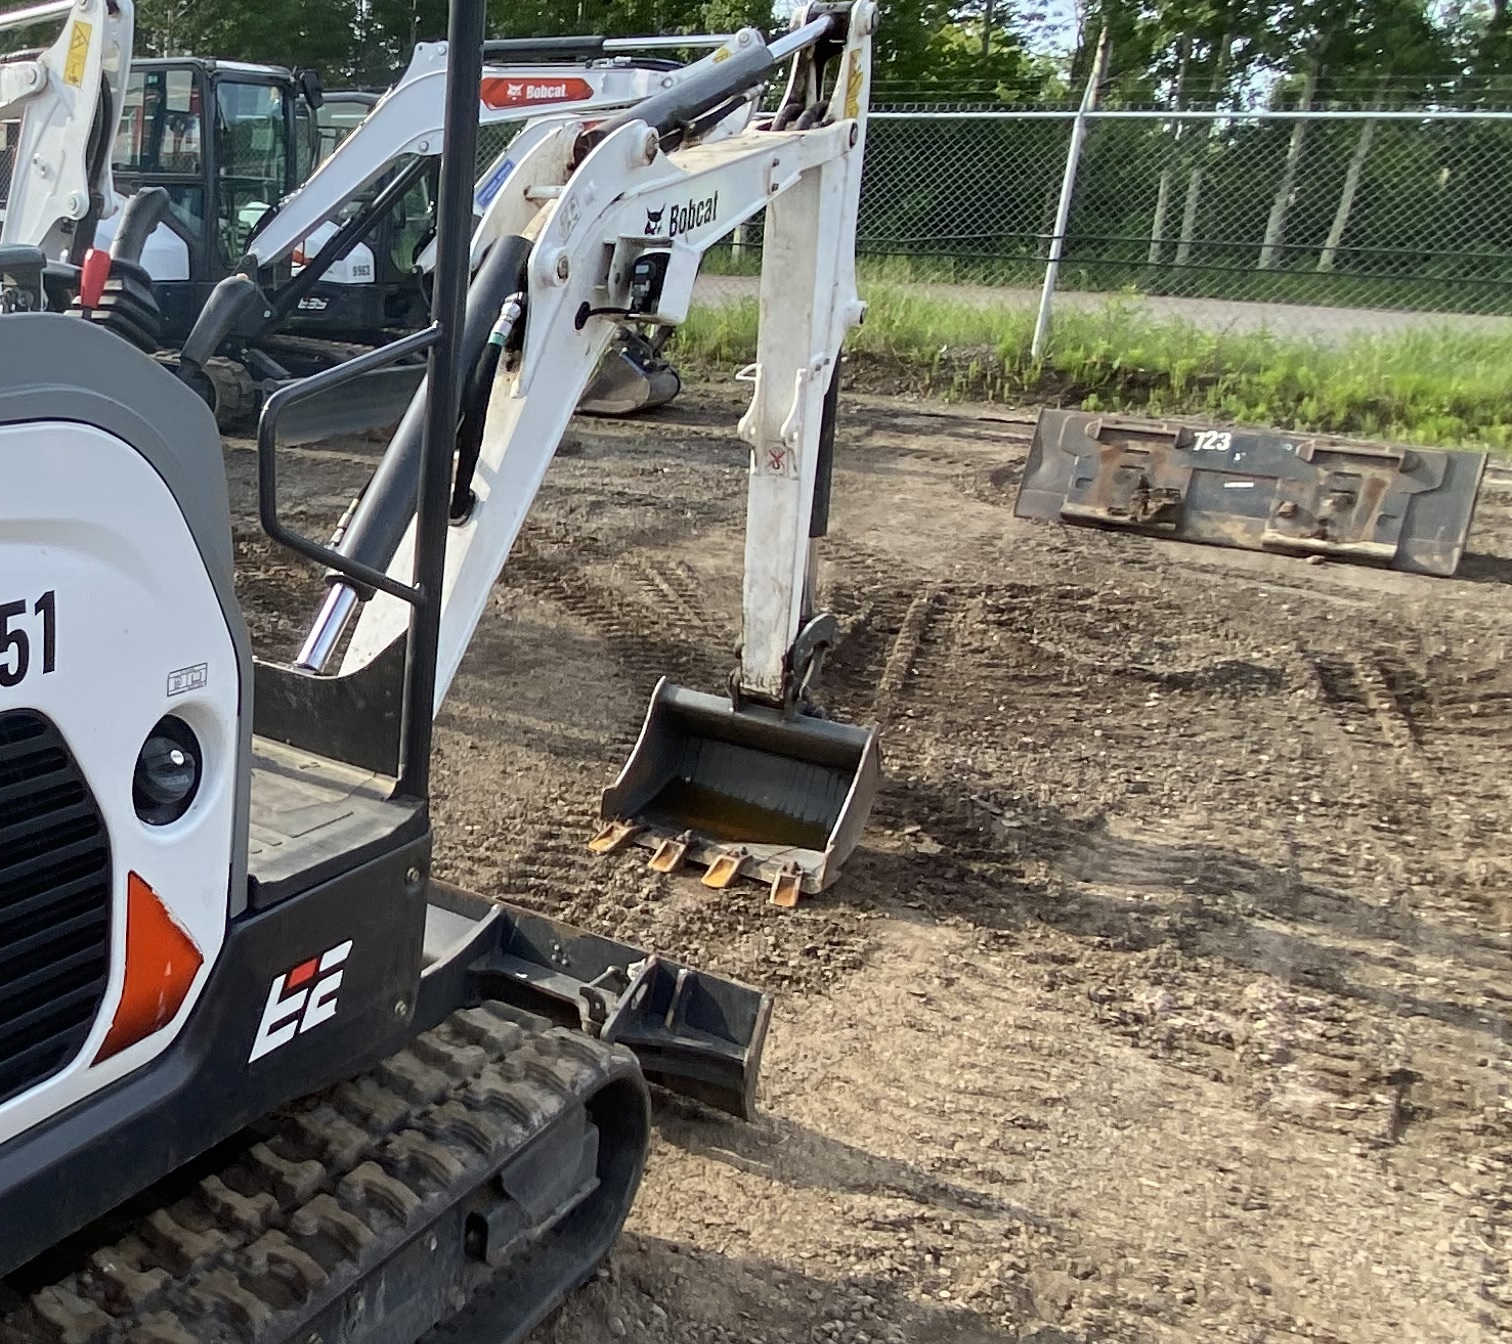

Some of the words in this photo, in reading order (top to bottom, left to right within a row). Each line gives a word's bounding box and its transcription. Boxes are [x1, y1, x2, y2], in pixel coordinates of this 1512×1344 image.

[526, 82, 567, 99] Bobcat
[669, 190, 719, 238] Bobcat
[1193, 430, 1232, 452] 723
